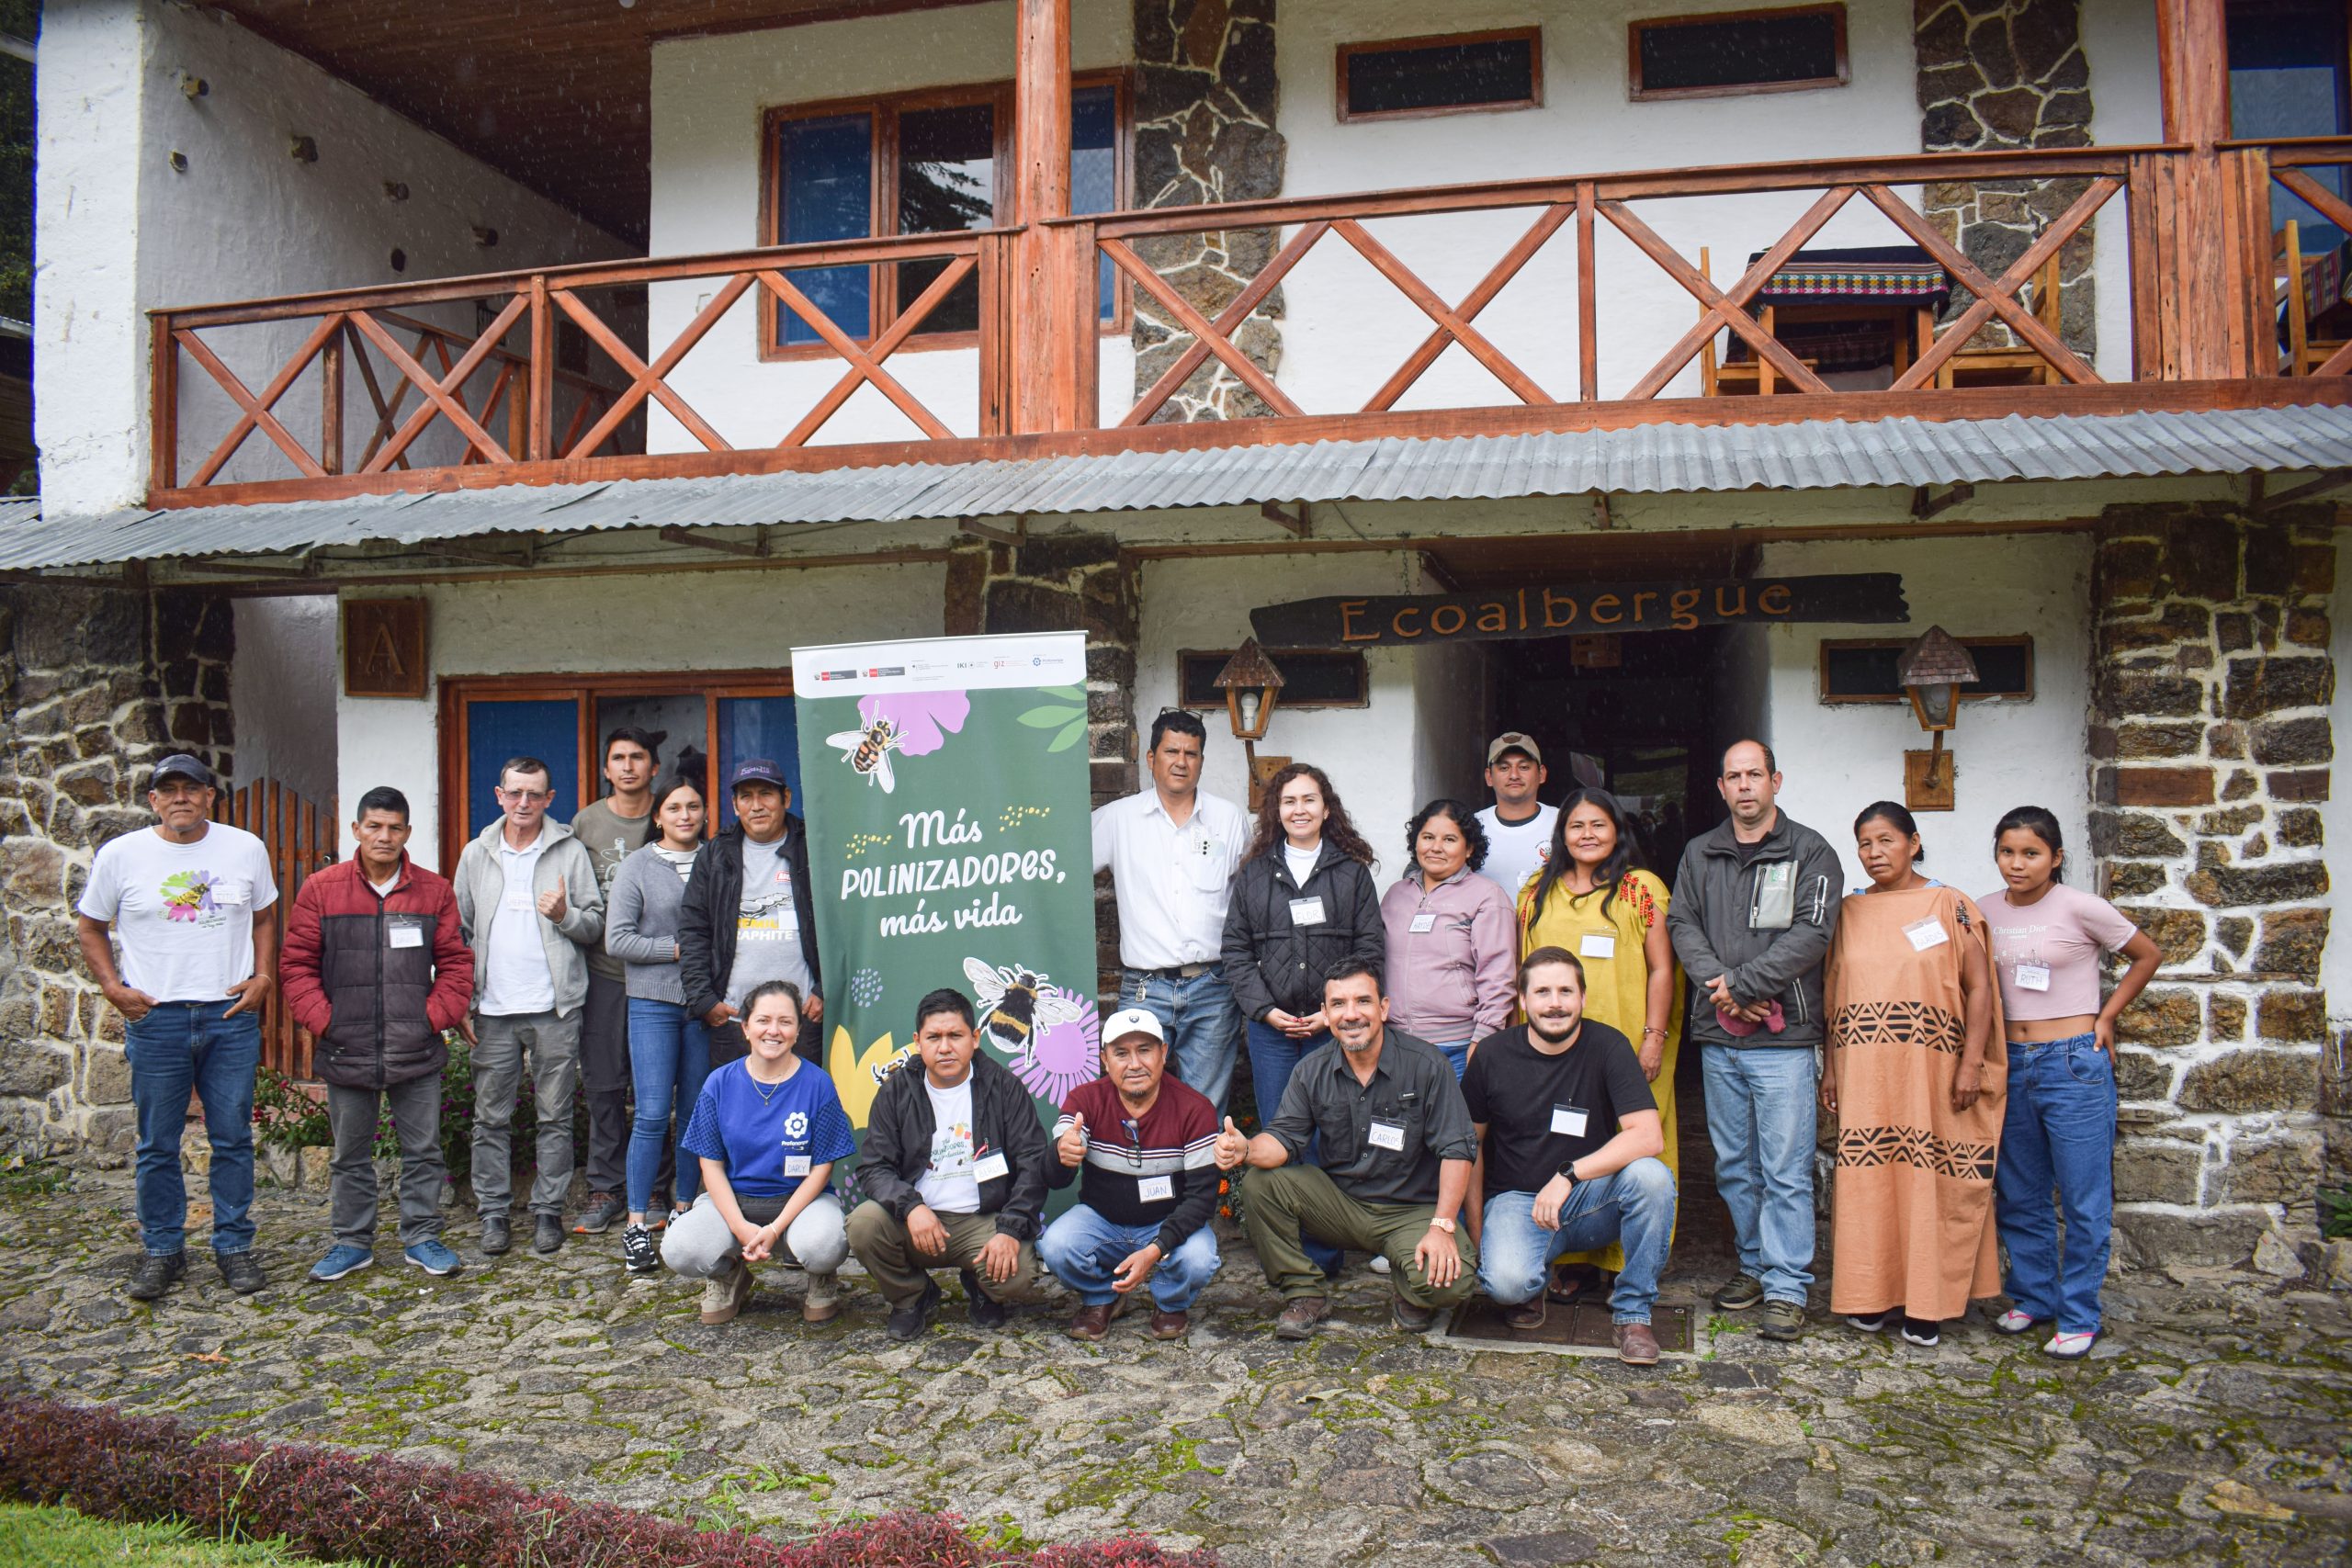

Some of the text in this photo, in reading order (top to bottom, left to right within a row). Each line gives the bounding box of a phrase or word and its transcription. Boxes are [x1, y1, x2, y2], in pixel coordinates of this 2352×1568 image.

[1339, 582, 1793, 642] Ecoalbergue
[366, 623, 408, 677] A
[993, 660, 1005, 669] giz
[899, 807, 983, 849] Más
[879, 891, 1023, 938] más vida
[737, 930, 794, 941] RAPHITE
[1993, 924, 2048, 934] Christian Dior
[2020, 974, 2042, 985] RUTH
[1372, 1131, 1400, 1146] CARLOS
[1145, 1185, 1167, 1198] JUAN
